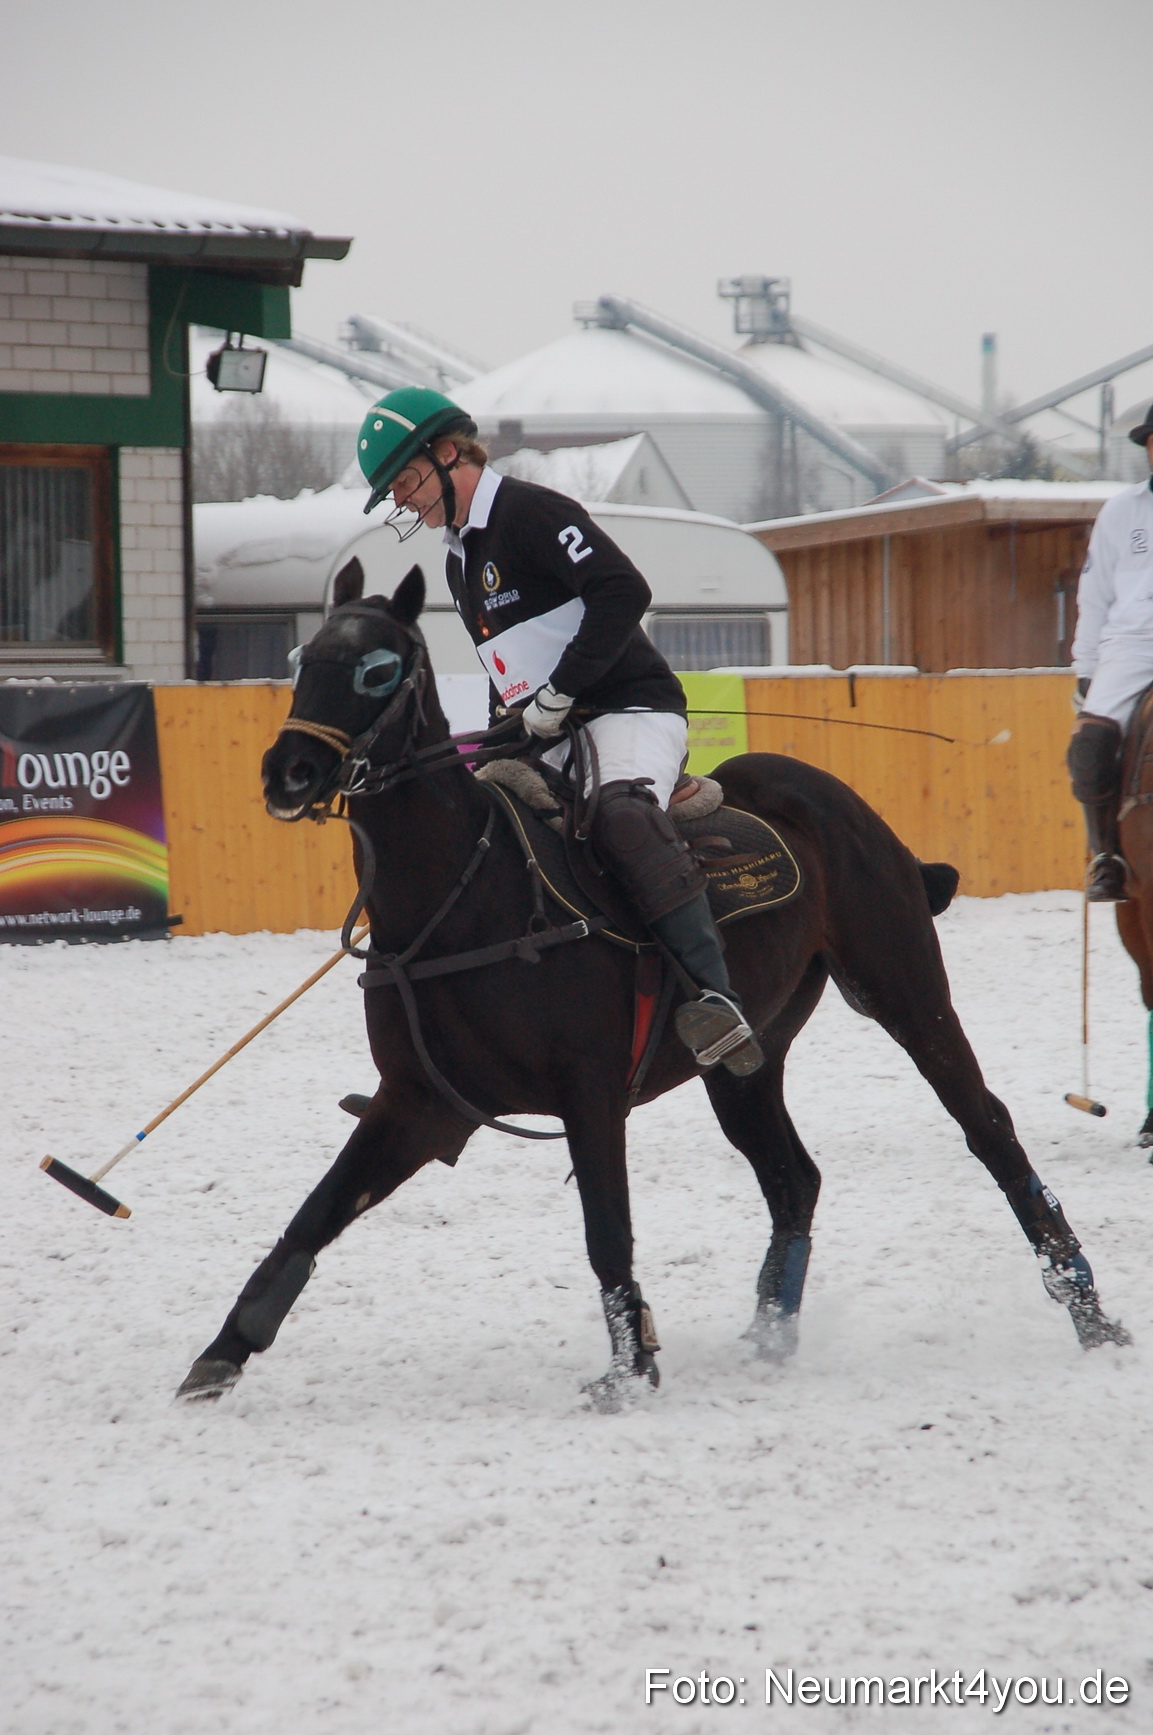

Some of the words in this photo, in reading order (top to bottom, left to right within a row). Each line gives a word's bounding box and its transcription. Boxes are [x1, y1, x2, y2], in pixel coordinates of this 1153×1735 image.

[557, 525, 593, 564] 2
[1130, 528, 1148, 554] 2
[22, 794, 74, 810] Events
